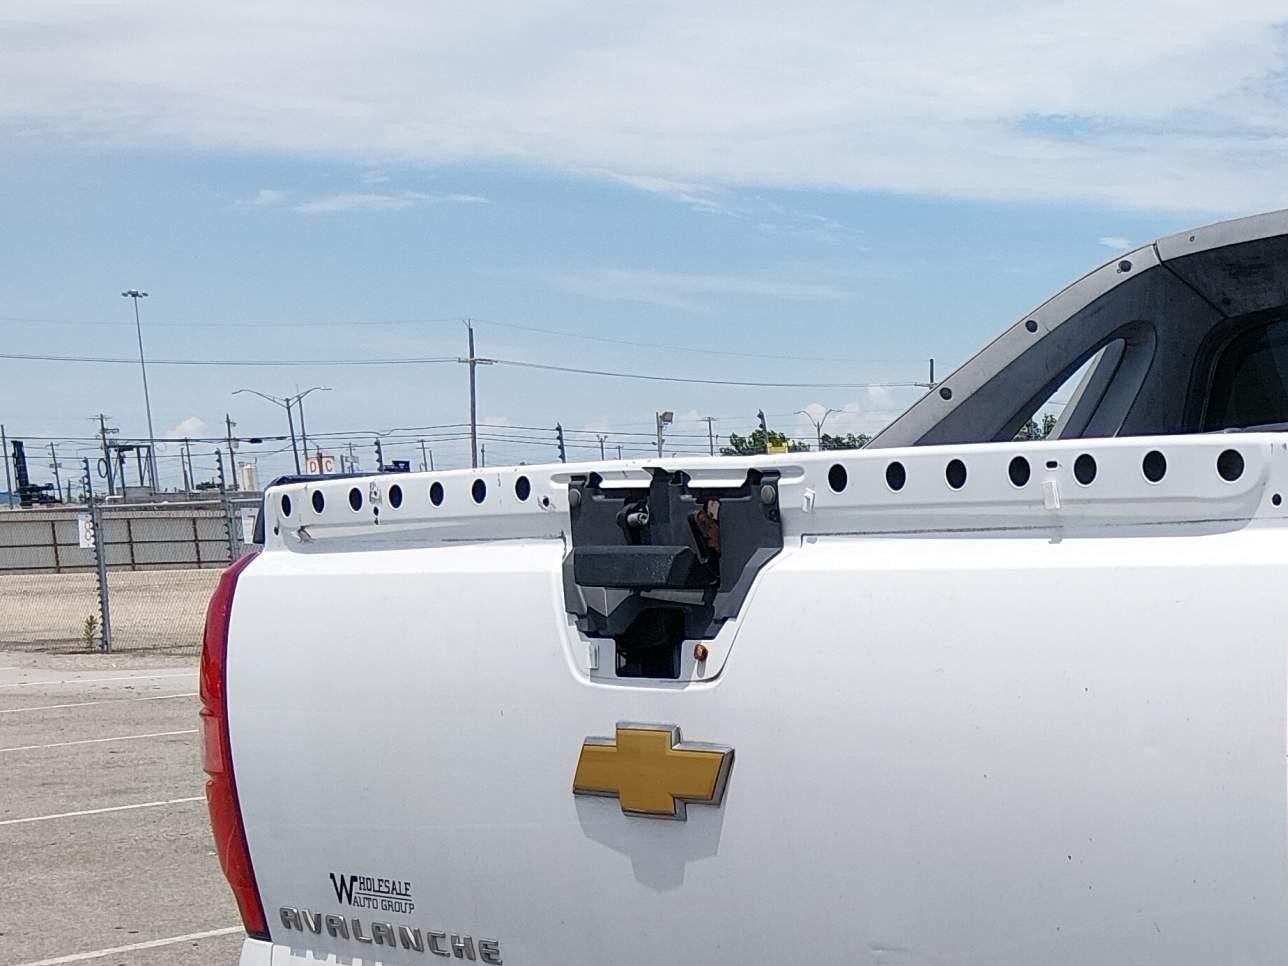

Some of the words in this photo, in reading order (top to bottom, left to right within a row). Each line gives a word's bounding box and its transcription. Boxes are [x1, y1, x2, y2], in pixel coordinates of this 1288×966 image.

[330, 873, 411, 904] WHOLESALE
[353, 896, 378, 909] AUTO
[381, 900, 415, 914] GROUP
[279, 906, 503, 965] AVALANCHE
